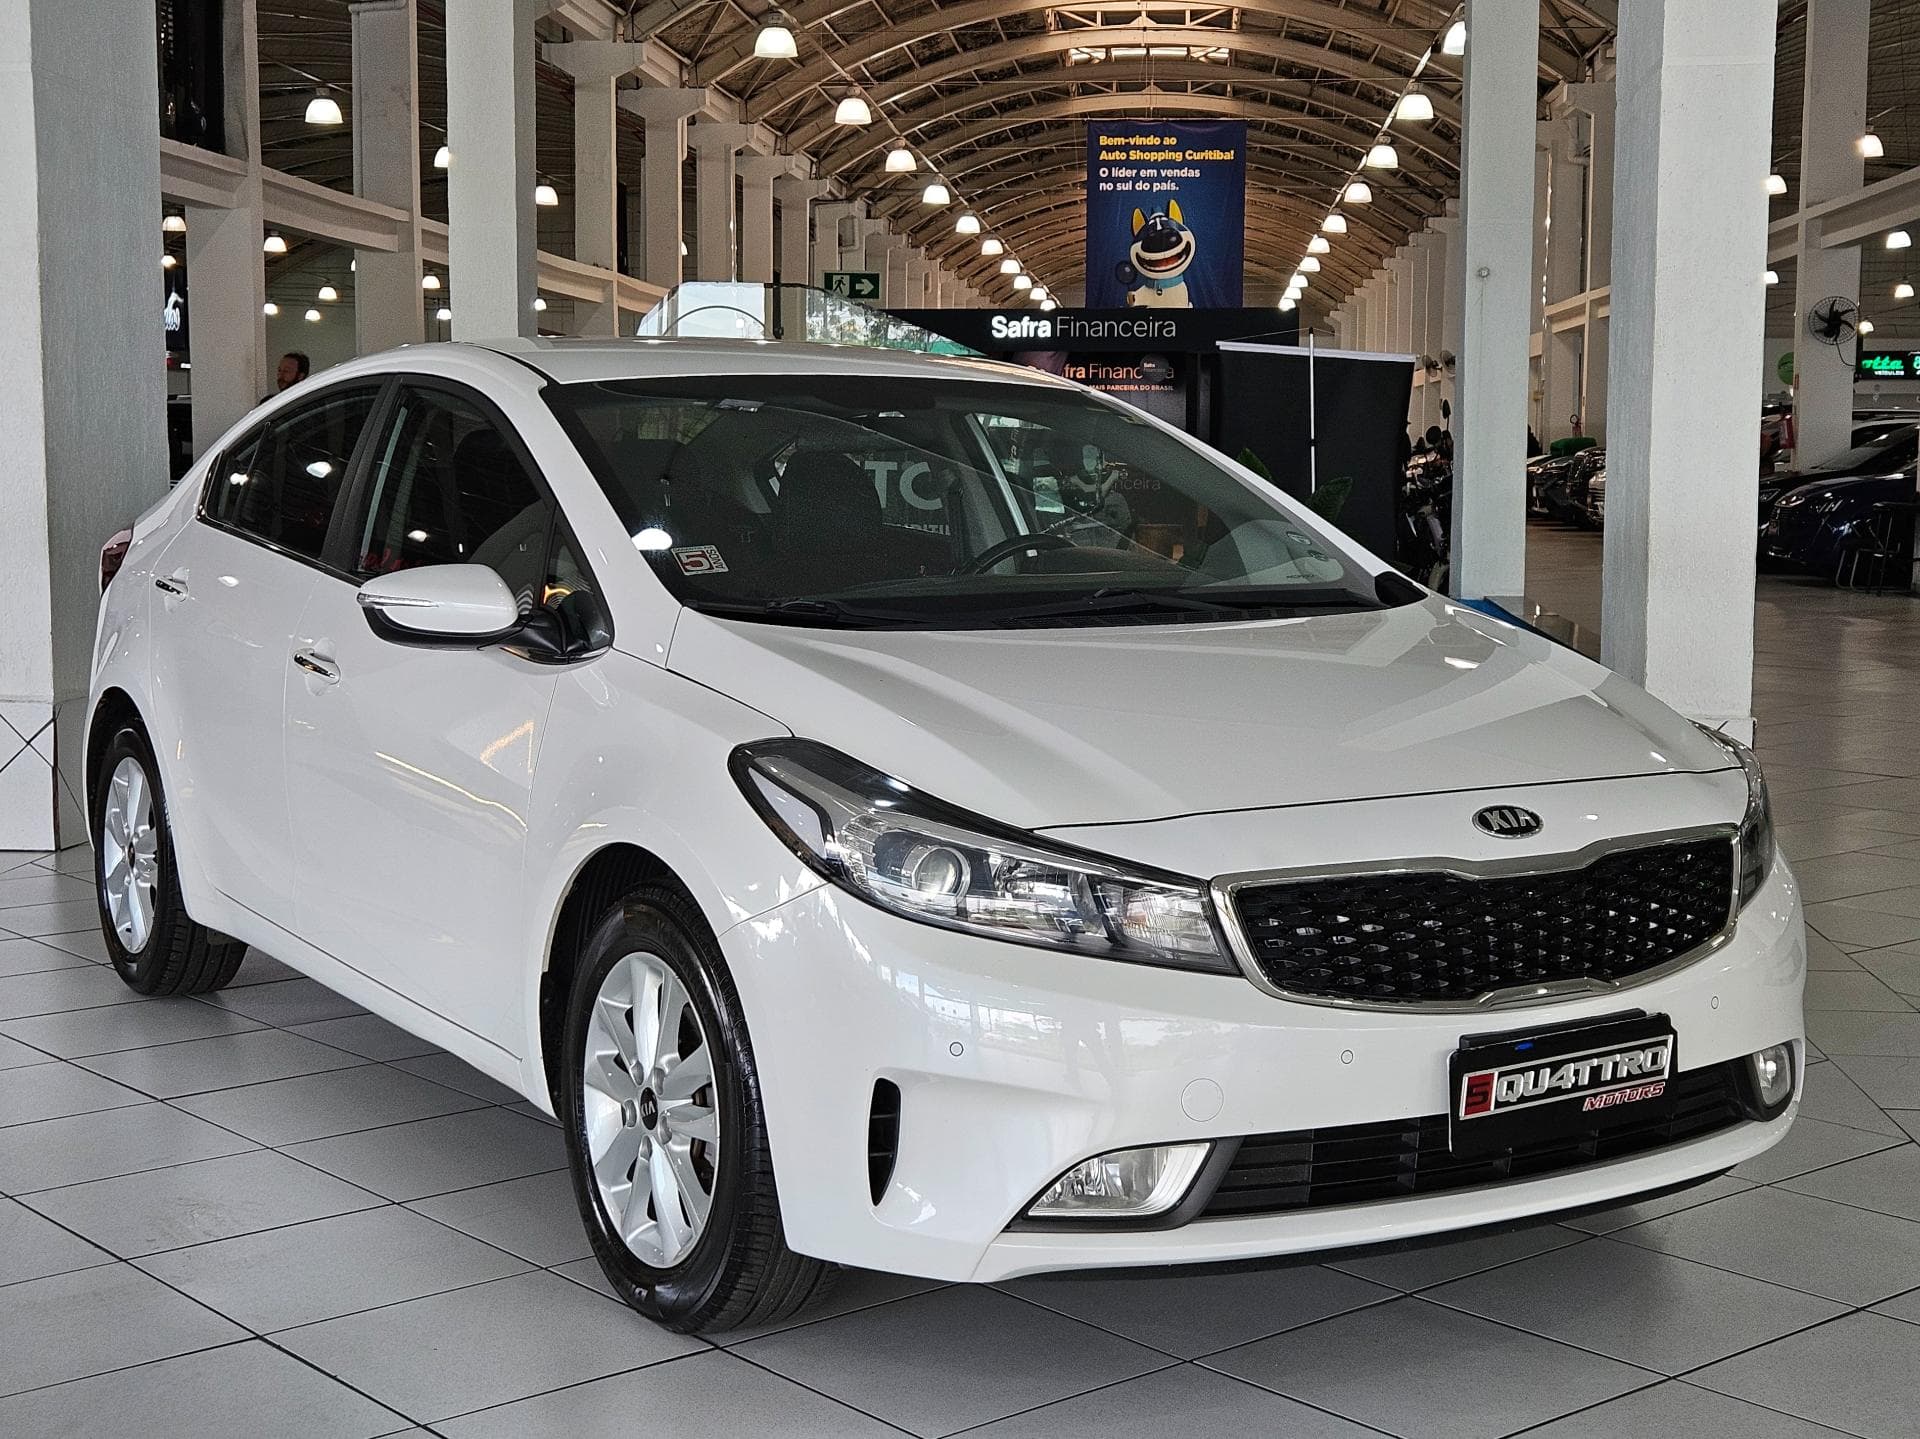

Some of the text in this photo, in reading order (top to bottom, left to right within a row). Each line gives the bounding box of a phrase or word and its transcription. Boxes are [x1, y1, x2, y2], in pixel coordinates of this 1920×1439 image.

[1099, 135, 1177, 146] Bem-vindo ao
[1099, 150, 1235, 162] Auto Shopping Curitiba!
[1099, 167, 1201, 178] O líder em vendas
[1099, 180, 1180, 193] no sul do país.
[991, 315, 1177, 339] Safra Financeira
[1482, 808, 1537, 831] KIA
[1582, 1082, 1666, 1112] MOTORS
[640, 1100, 656, 1117] KIA
